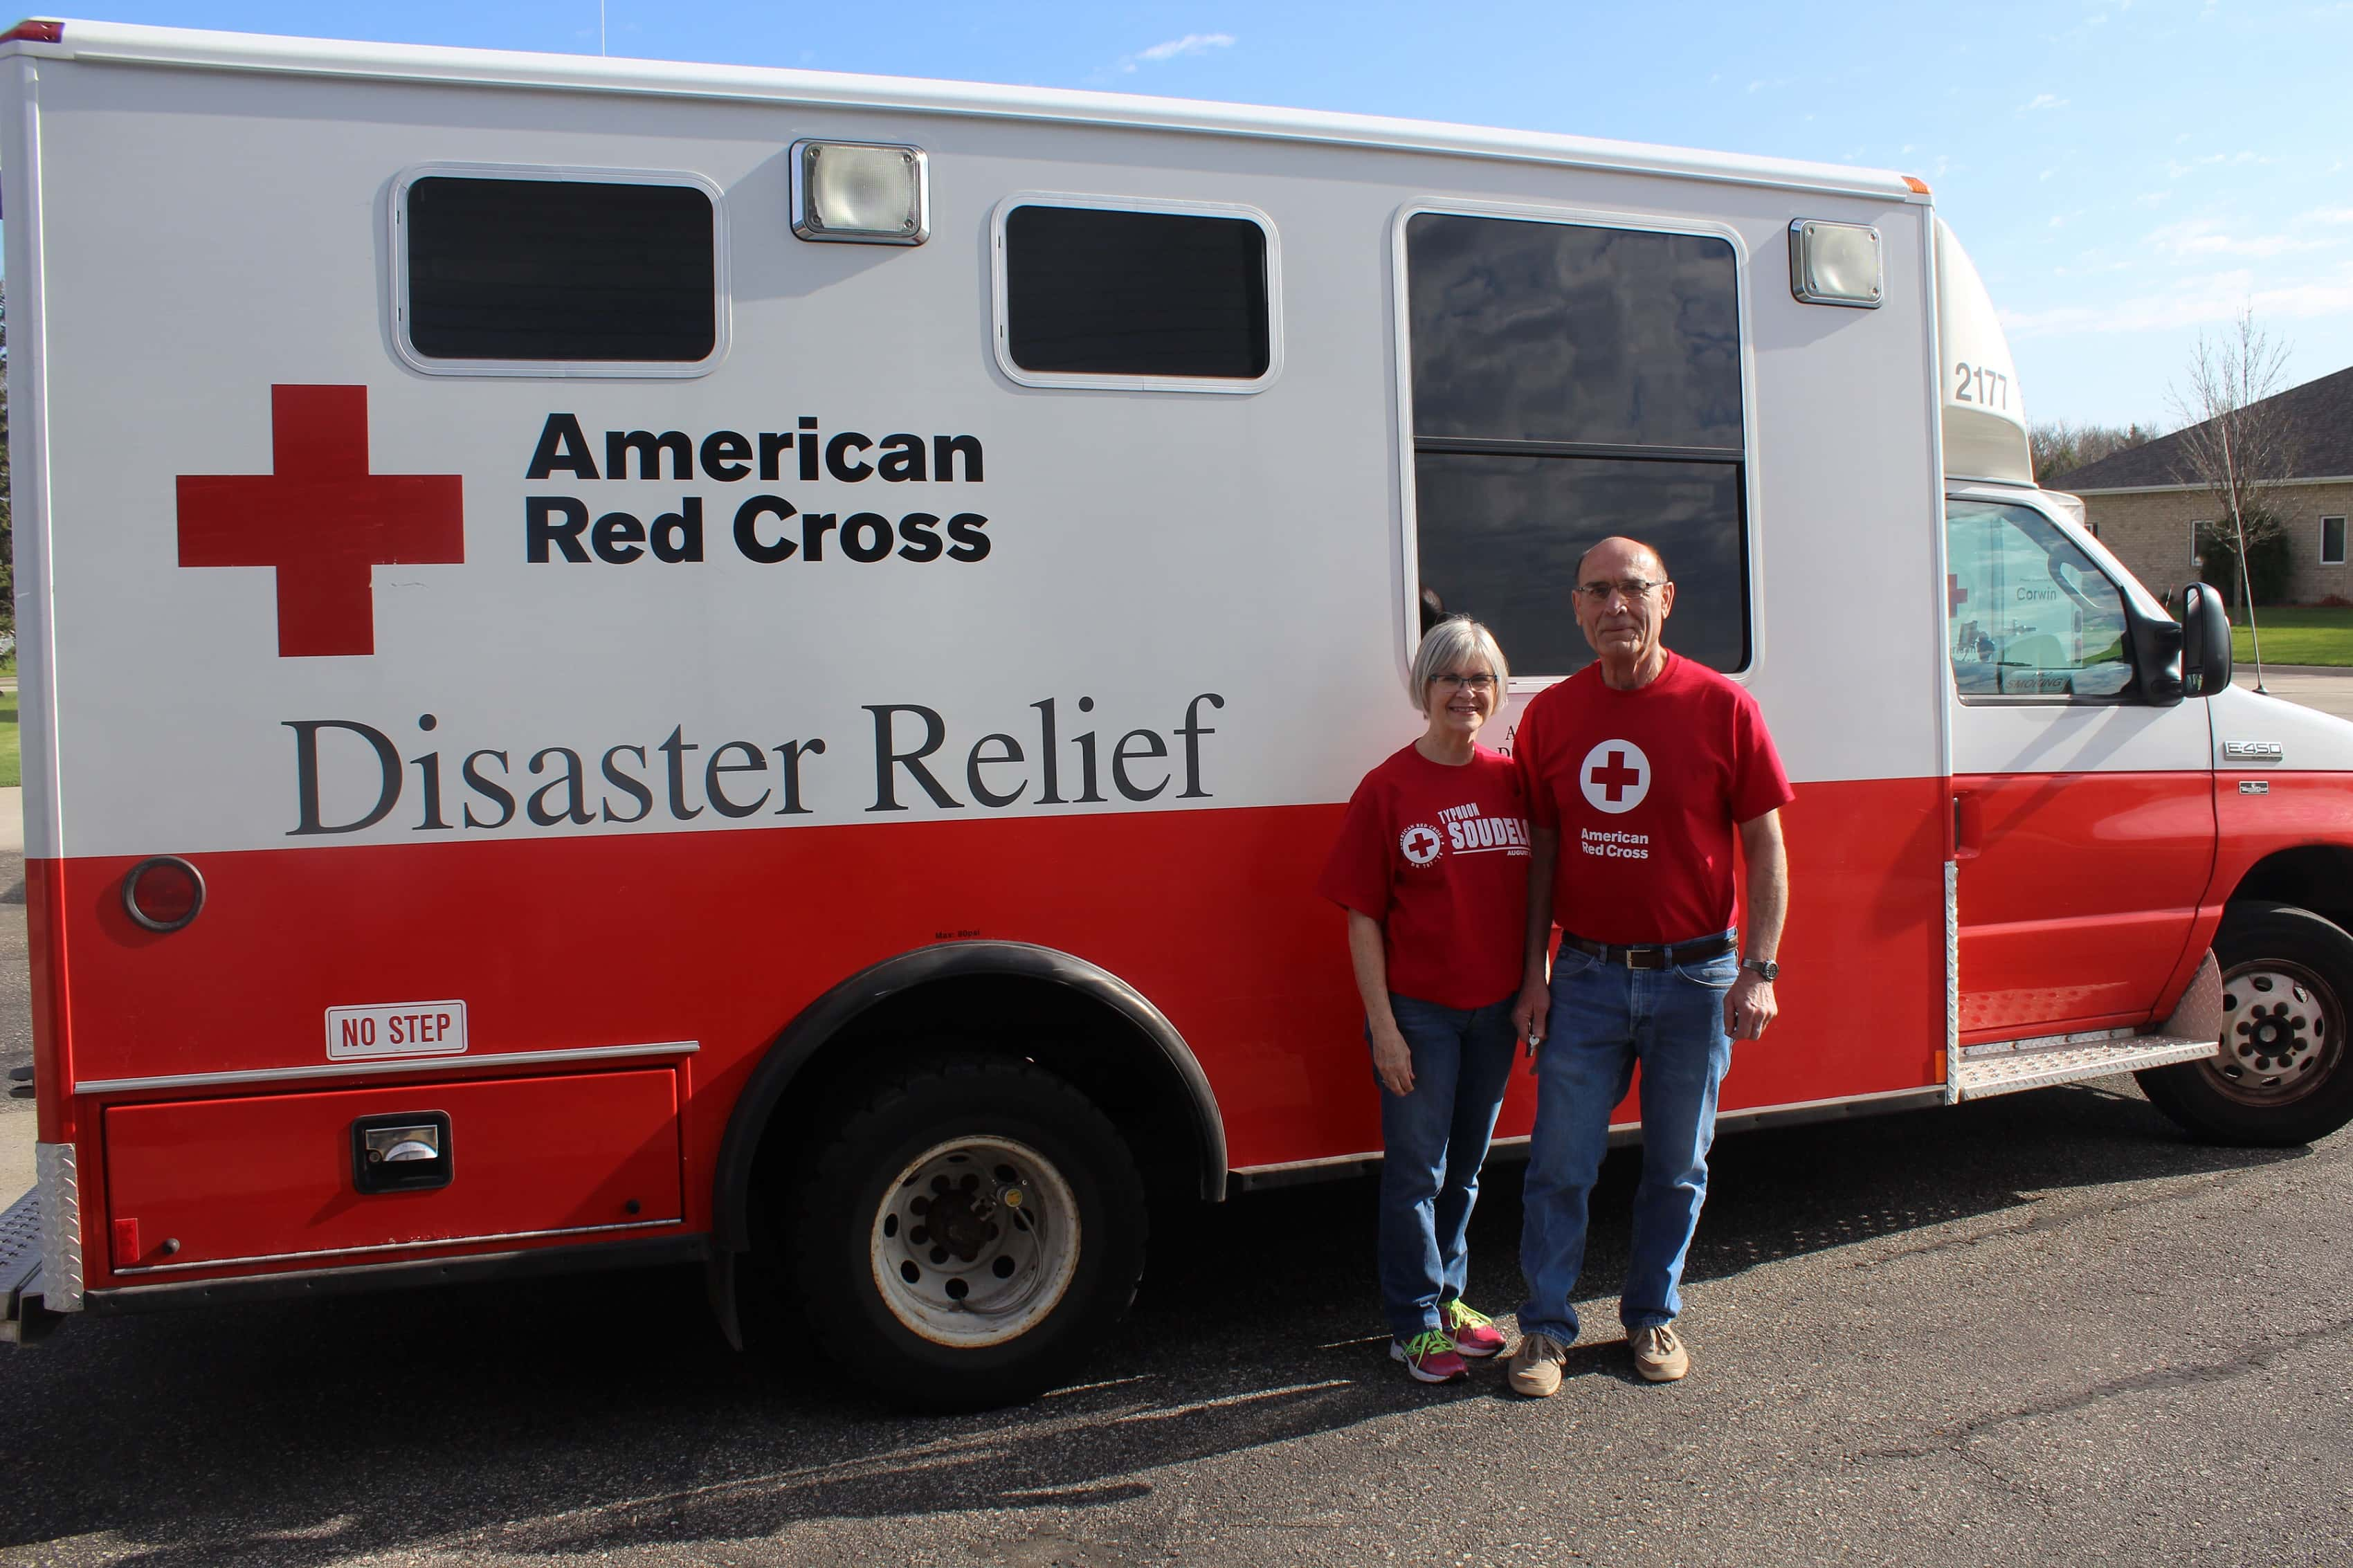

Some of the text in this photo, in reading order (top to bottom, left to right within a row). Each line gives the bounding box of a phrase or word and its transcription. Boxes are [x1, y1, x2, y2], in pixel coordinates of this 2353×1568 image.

[1955, 362, 2007, 410] 2177
[525, 413, 984, 483] American
[525, 495, 992, 565] Red Cross
[2016, 586, 2057, 601] Corwin
[281, 693, 1226, 837] Disaster Relief
[1437, 802, 1480, 825] TYPHOON
[1581, 828, 1649, 845] American
[1581, 841, 1649, 859] Red Cross
[342, 1013, 451, 1047] NO STEP
